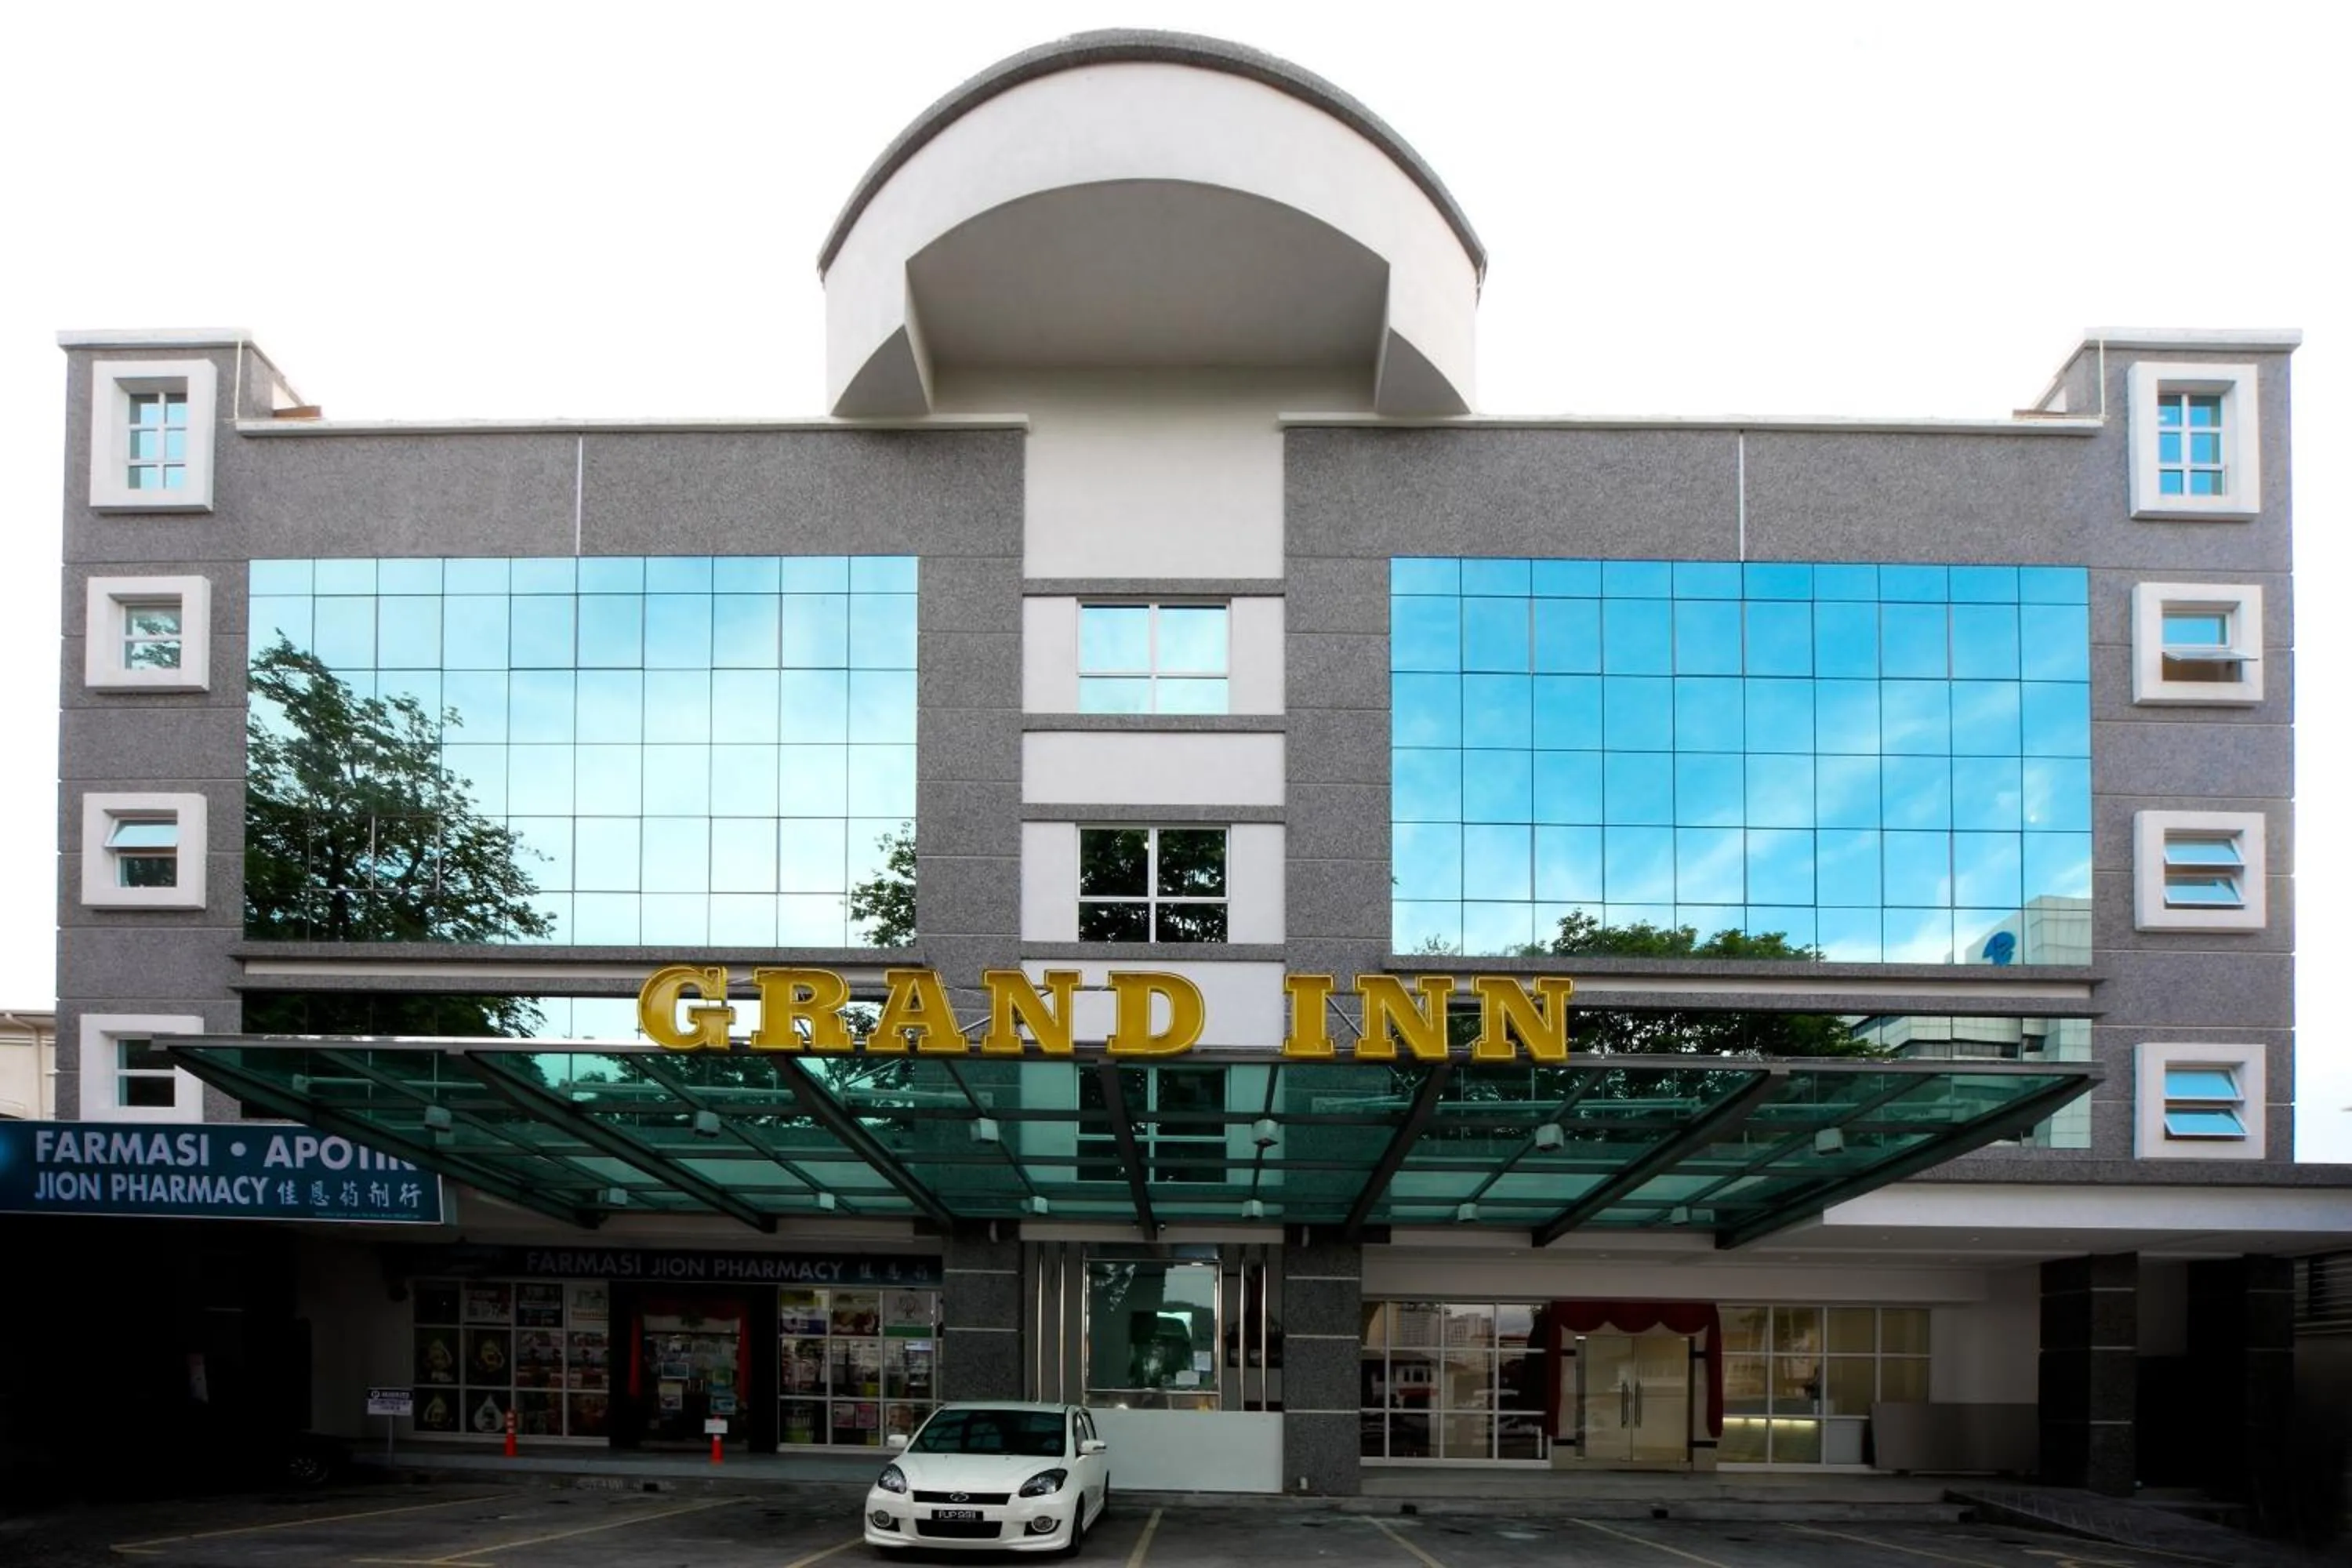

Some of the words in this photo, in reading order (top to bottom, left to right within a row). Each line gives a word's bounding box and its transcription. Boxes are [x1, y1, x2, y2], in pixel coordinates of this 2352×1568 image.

[637, 964, 1205, 1056] GRAND
[1283, 974, 1574, 1063] INN
[34, 1130, 210, 1167] FARMASI
[34, 1170, 101, 1201] JION
[111, 1173, 270, 1206] PHARMACY
[525, 1250, 642, 1275] FARMASI
[650, 1256, 706, 1277] JION
[713, 1258, 844, 1280] PHARMACY
